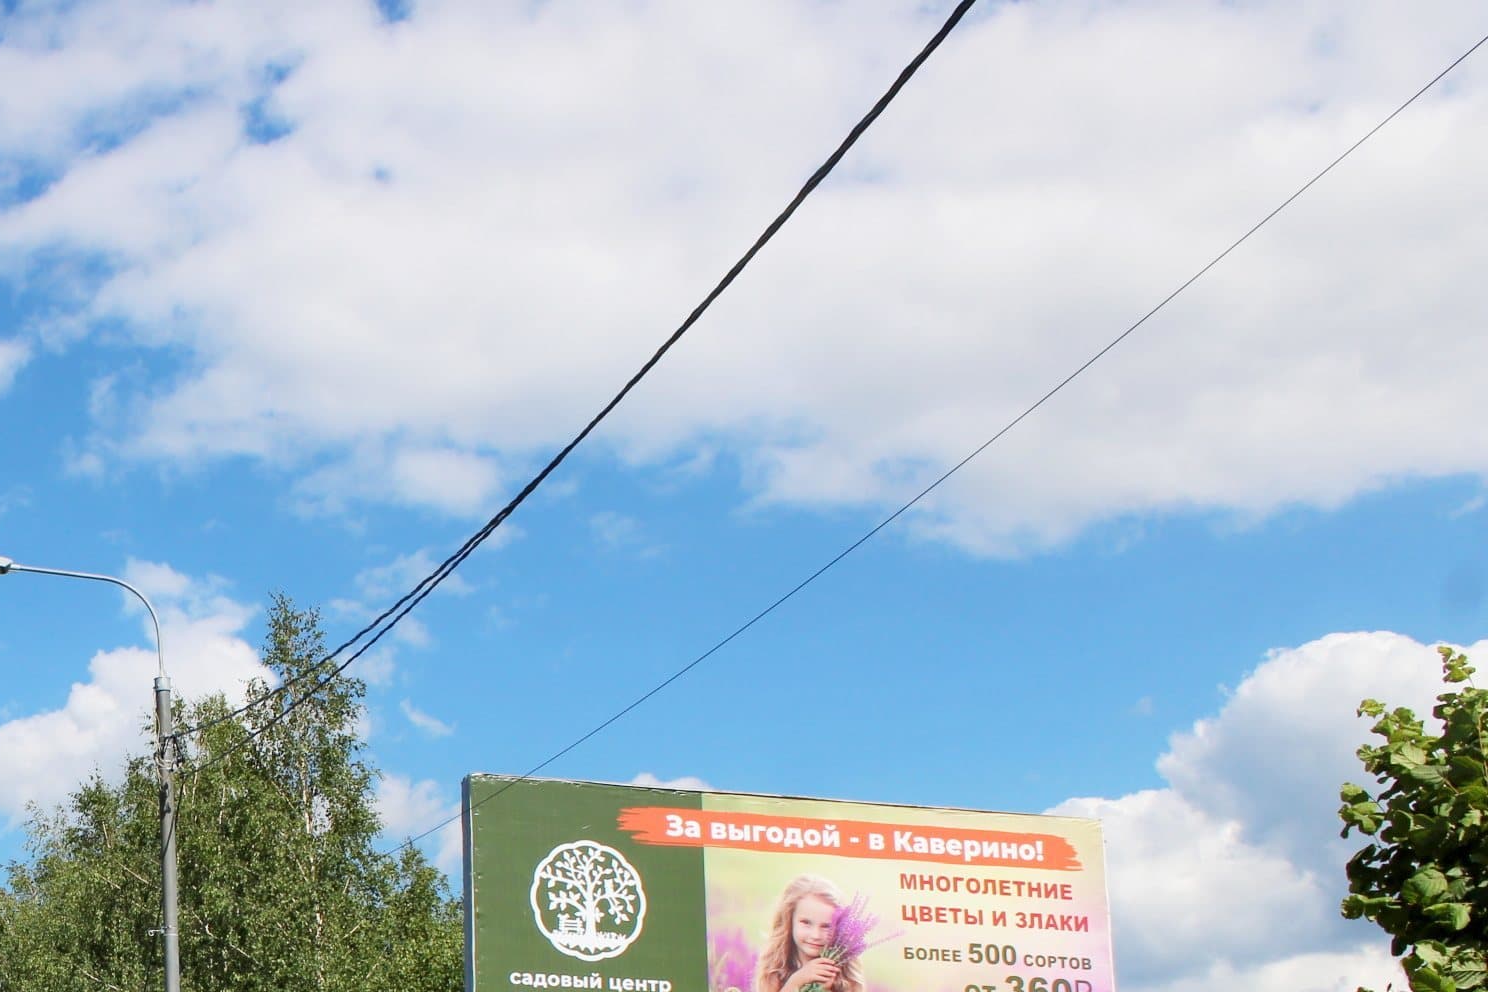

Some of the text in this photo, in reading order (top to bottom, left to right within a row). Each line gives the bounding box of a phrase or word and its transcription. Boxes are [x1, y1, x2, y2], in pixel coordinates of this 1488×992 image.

[665, 814, 701, 838] За
[710, 822, 840, 848] выгодой
[869, 833, 885, 850] в
[894, 830, 1044, 861] Каверино!
[900, 873, 1073, 900] МНОГОЛЕТНИЕ
[902, 904, 1089, 932] ЦВЕТЫ И ЗЛАКИ
[903, 943, 1092, 970] БОЛЕЕ 500 СОРТОВ
[509, 972, 602, 989] садовый
